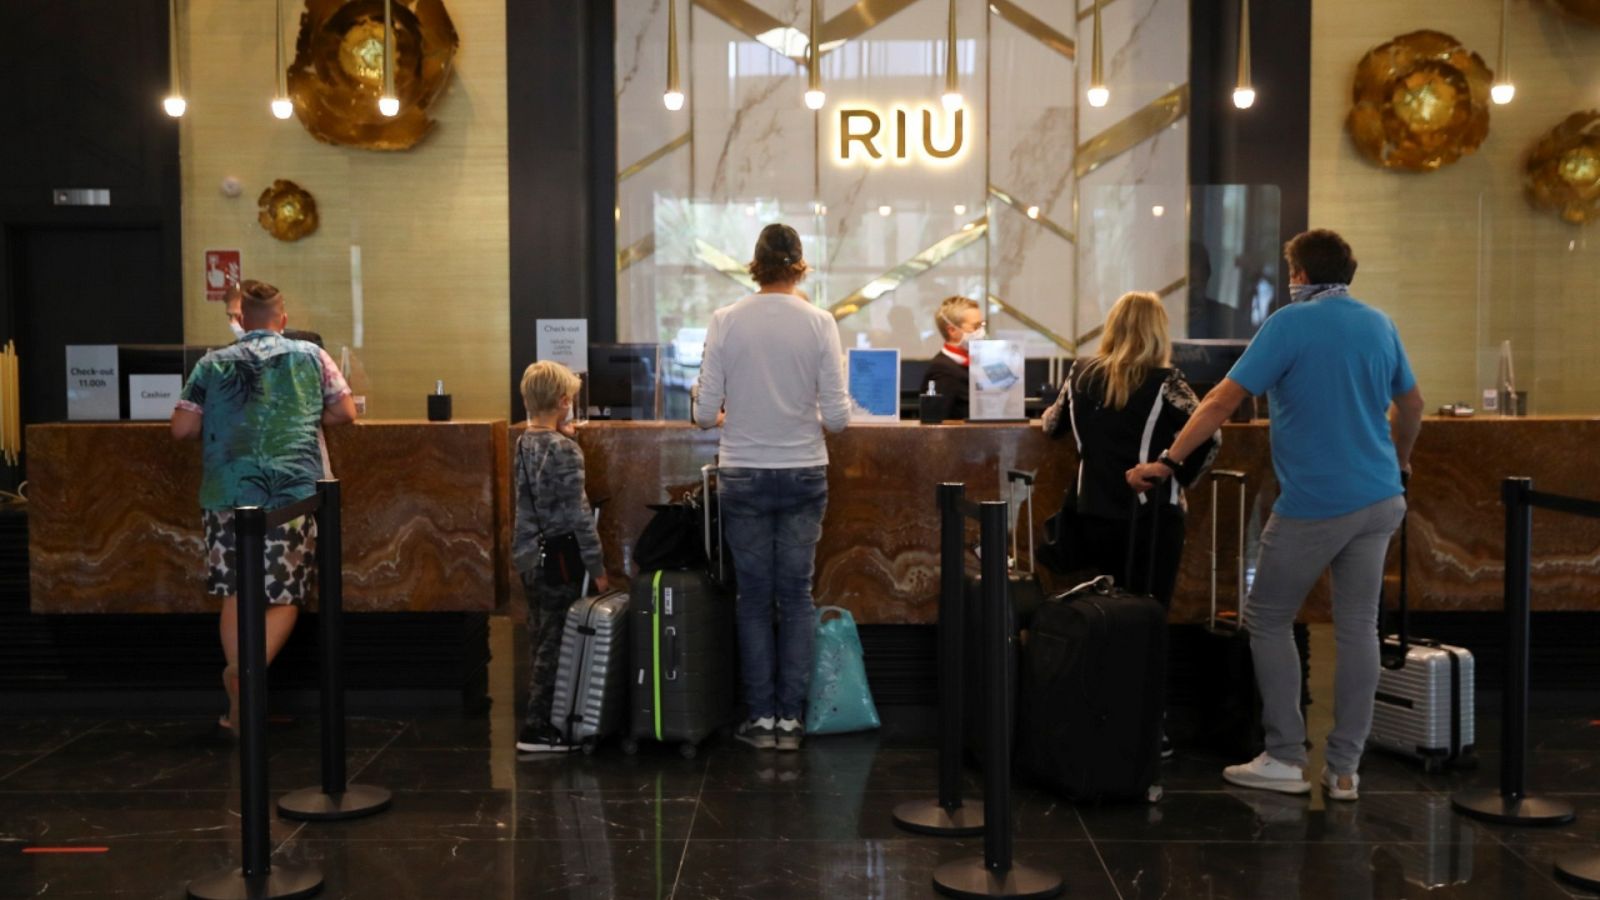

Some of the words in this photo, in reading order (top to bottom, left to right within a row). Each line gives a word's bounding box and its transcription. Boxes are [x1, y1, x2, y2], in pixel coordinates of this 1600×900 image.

[840, 109, 964, 159] RIU
[70, 367, 114, 376] Check-out
[78, 379, 107, 387] 11.00h
[140, 390, 171, 399] Cashier
